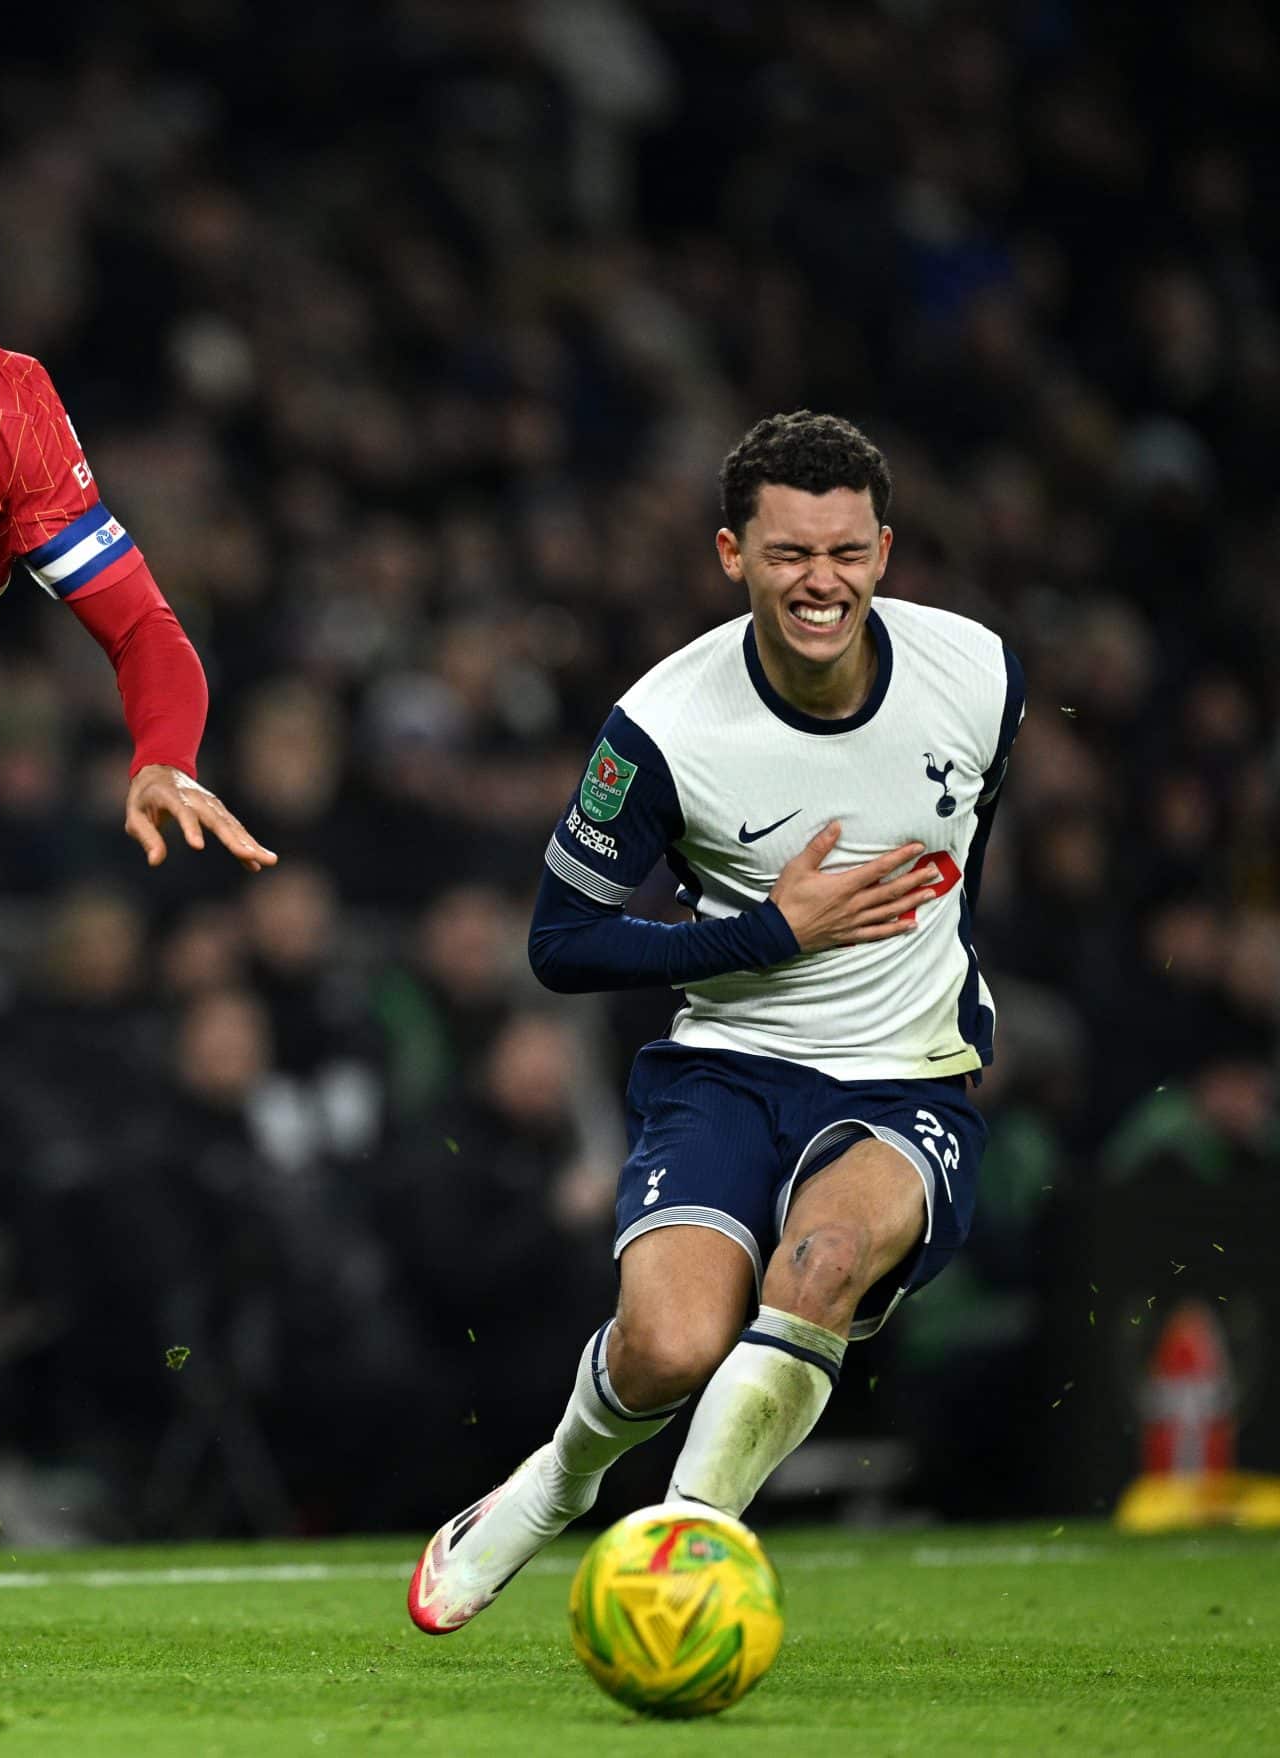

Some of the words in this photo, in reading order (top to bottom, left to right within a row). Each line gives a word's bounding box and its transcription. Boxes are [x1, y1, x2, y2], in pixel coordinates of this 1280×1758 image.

[587, 771, 622, 797] Carabao
[590, 786, 608, 801] Cup
[576, 830, 619, 860] racism
[580, 822, 616, 848] room
